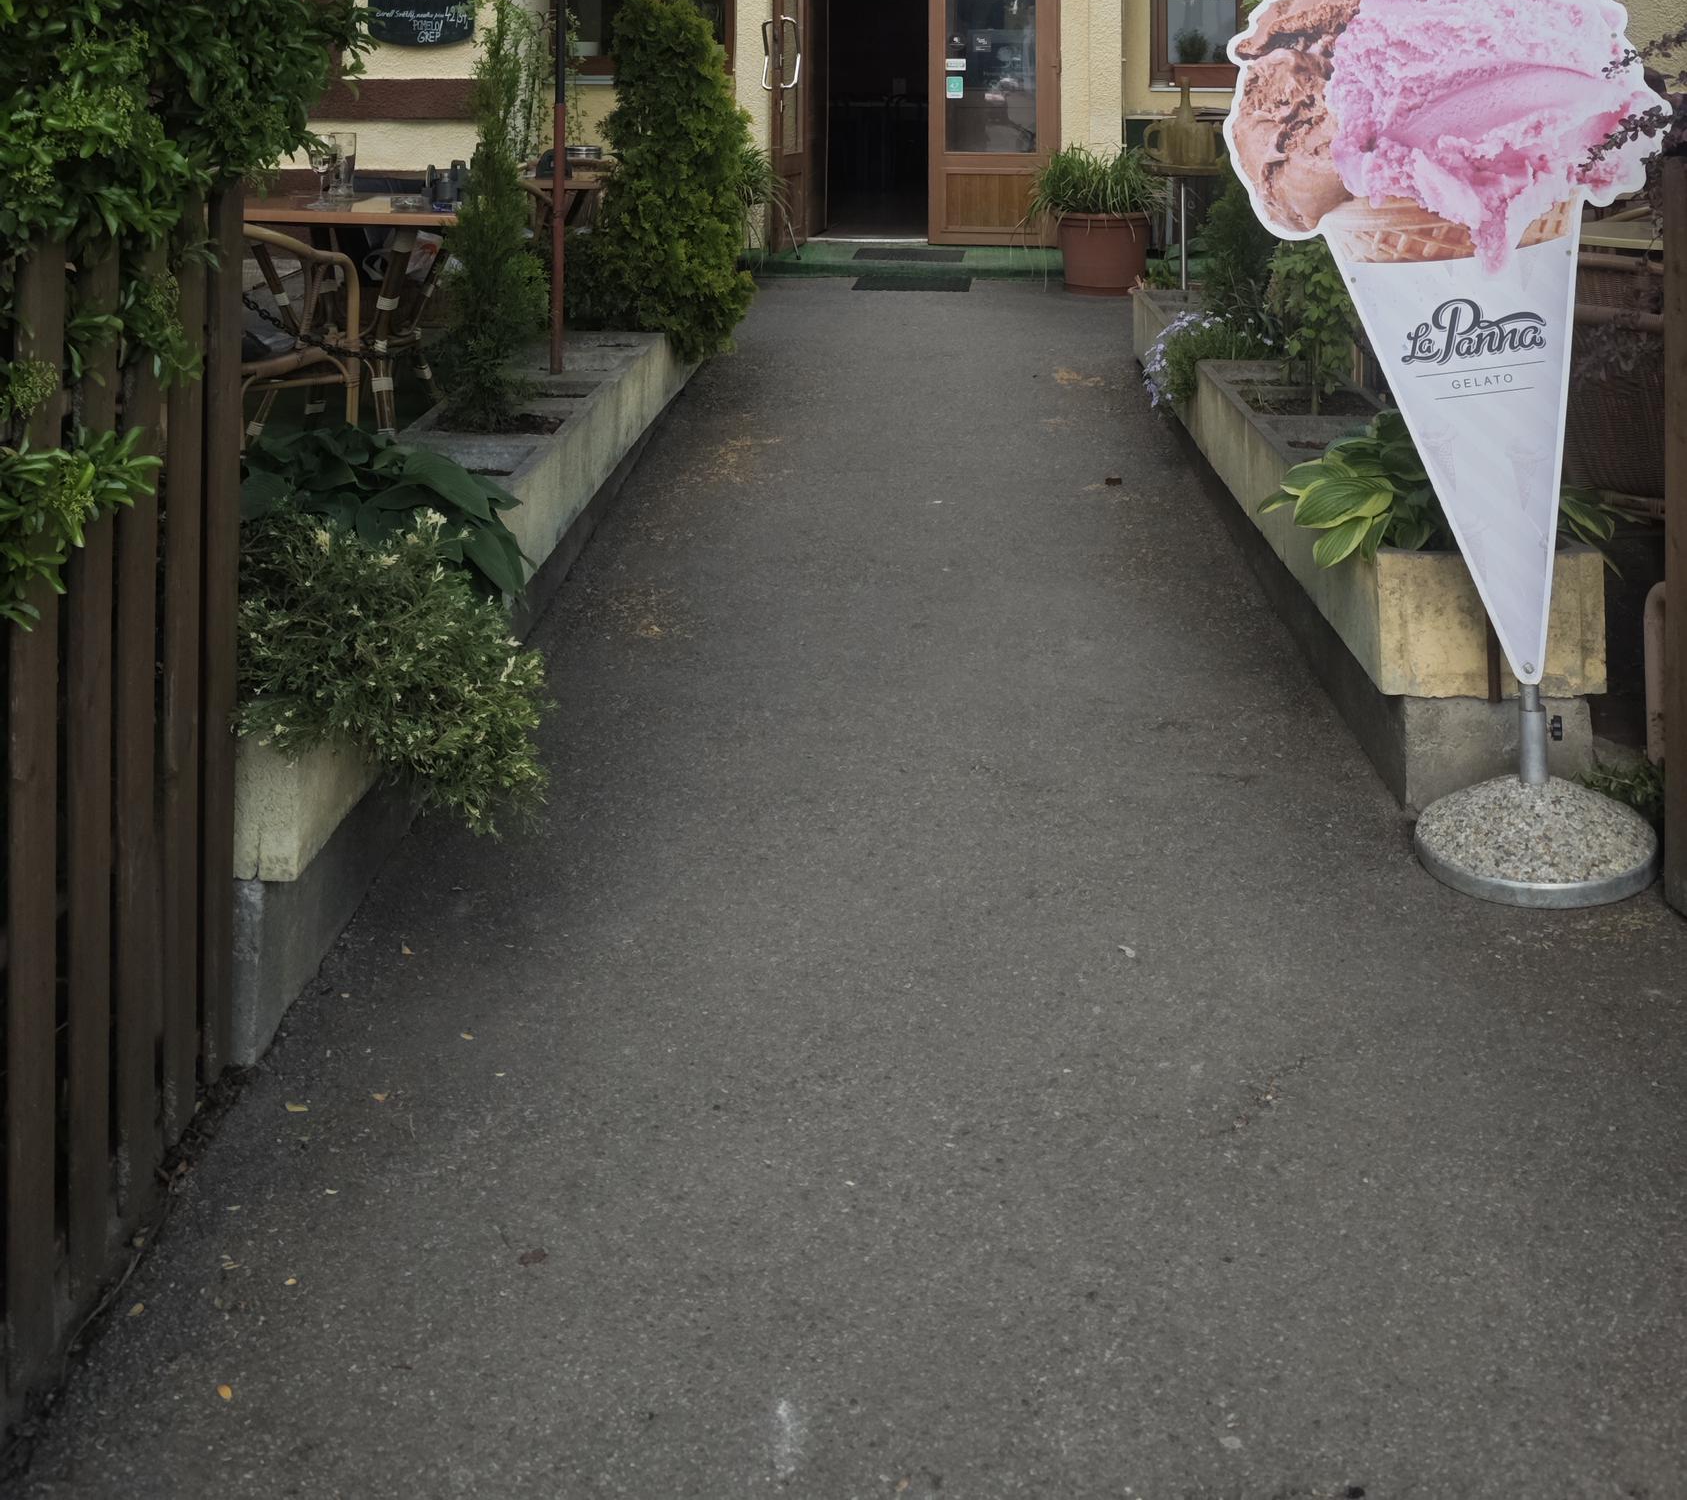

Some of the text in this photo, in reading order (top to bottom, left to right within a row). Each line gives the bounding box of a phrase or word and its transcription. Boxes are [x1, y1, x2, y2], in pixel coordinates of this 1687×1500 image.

[1401, 298, 1546, 366] La Panna
[1452, 373, 1513, 389] GELATO
